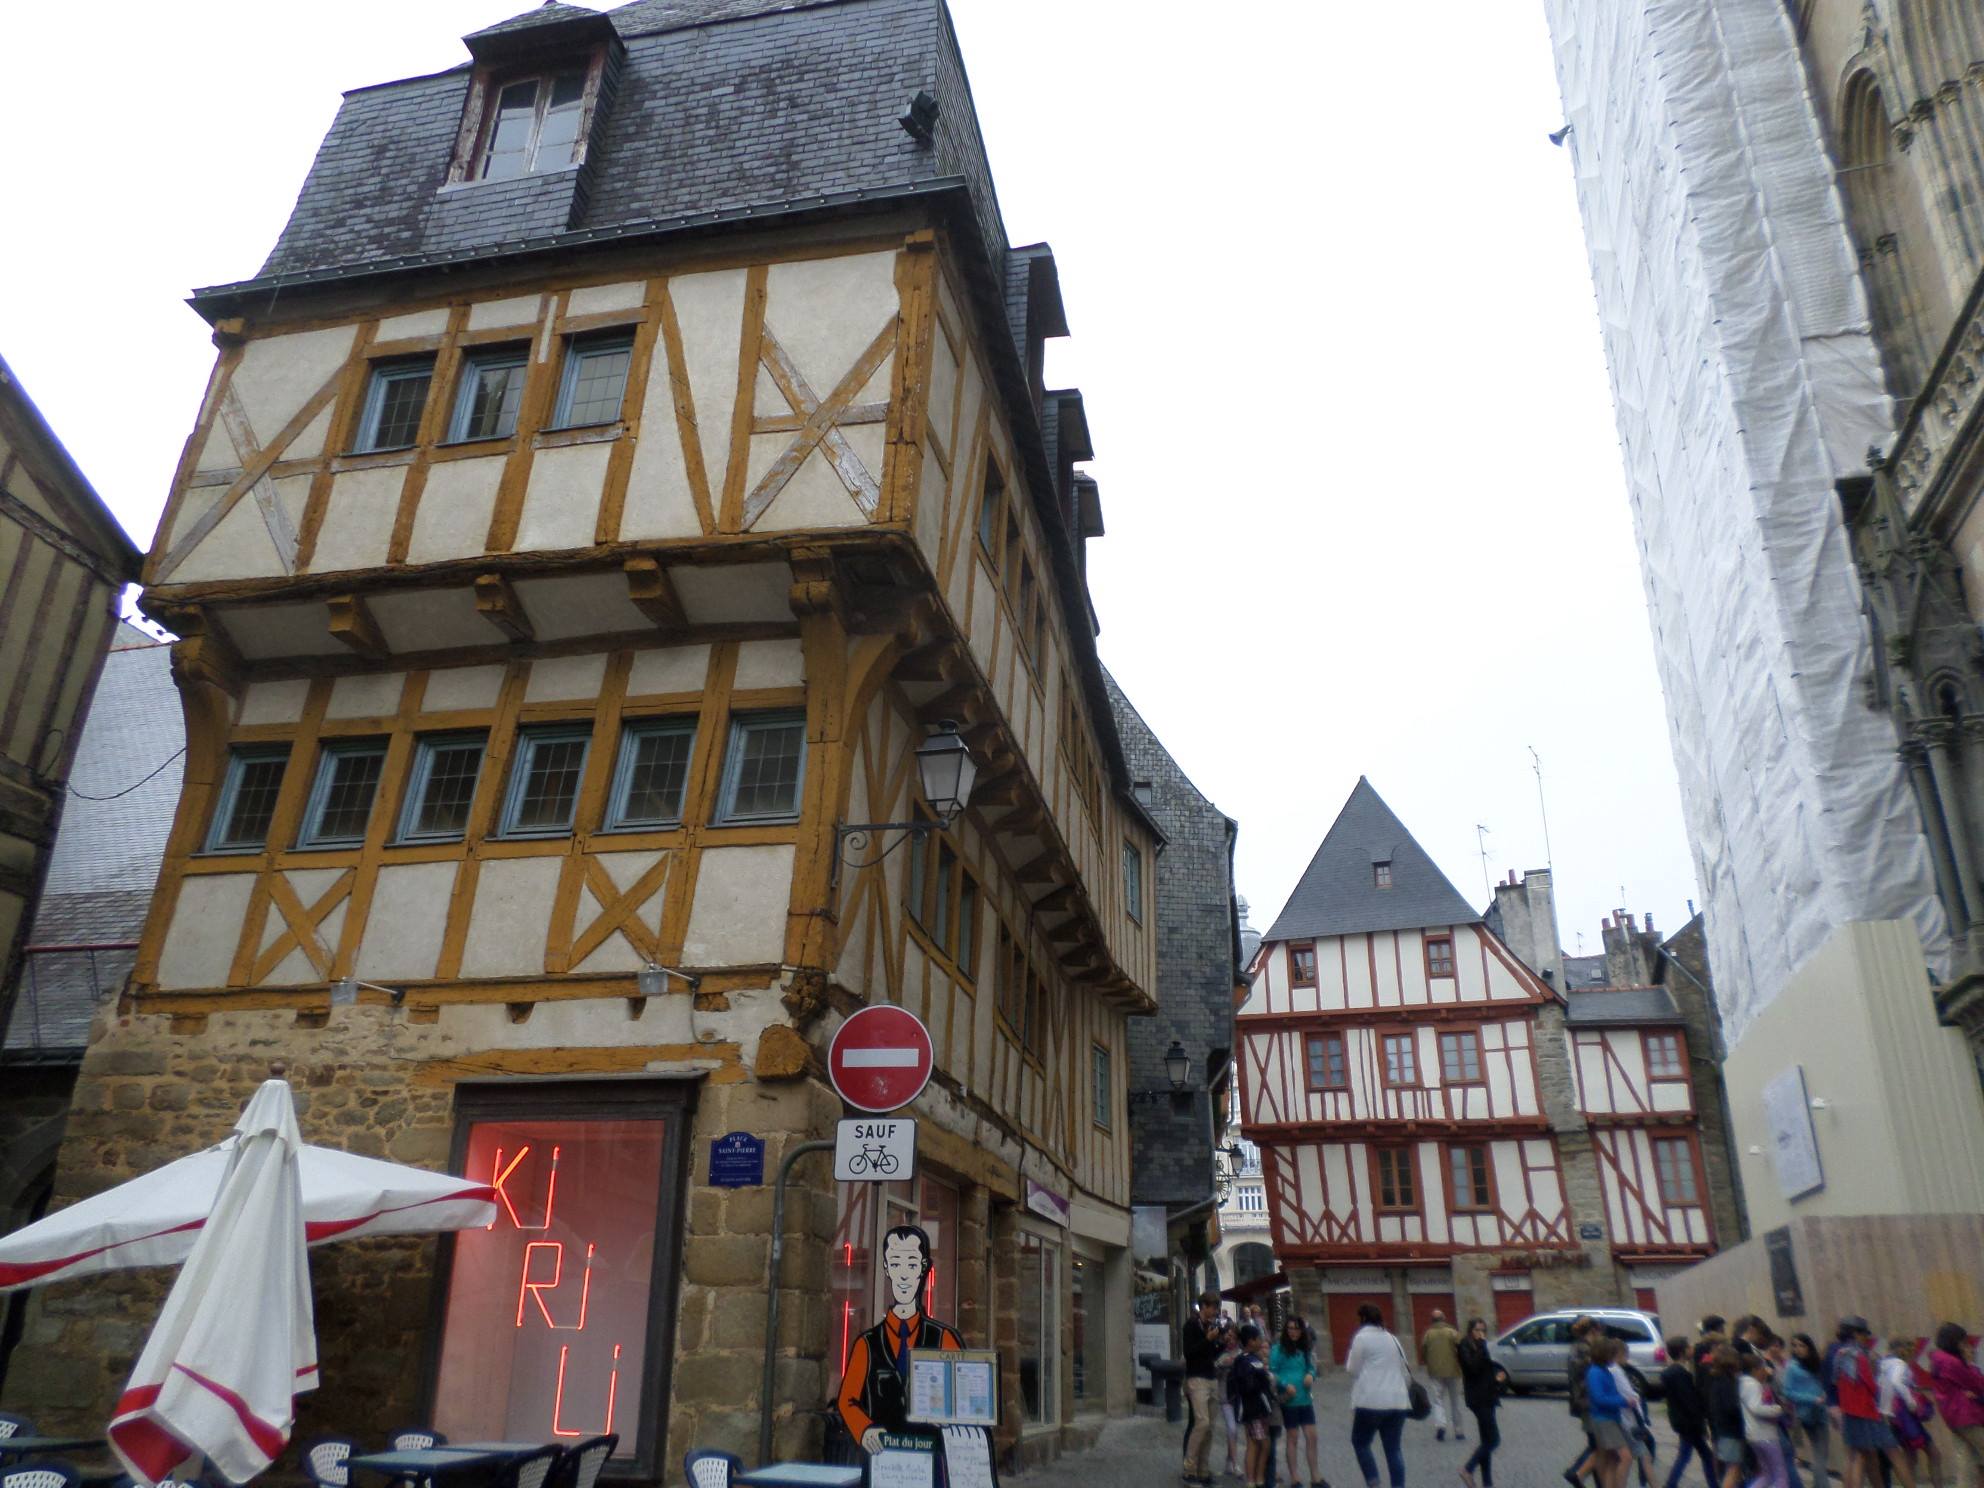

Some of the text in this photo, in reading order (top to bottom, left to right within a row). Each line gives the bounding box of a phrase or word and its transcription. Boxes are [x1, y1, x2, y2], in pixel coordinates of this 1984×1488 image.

[855, 1124, 897, 1139] SAUF
[884, 1435, 933, 1450] Plat du jour
